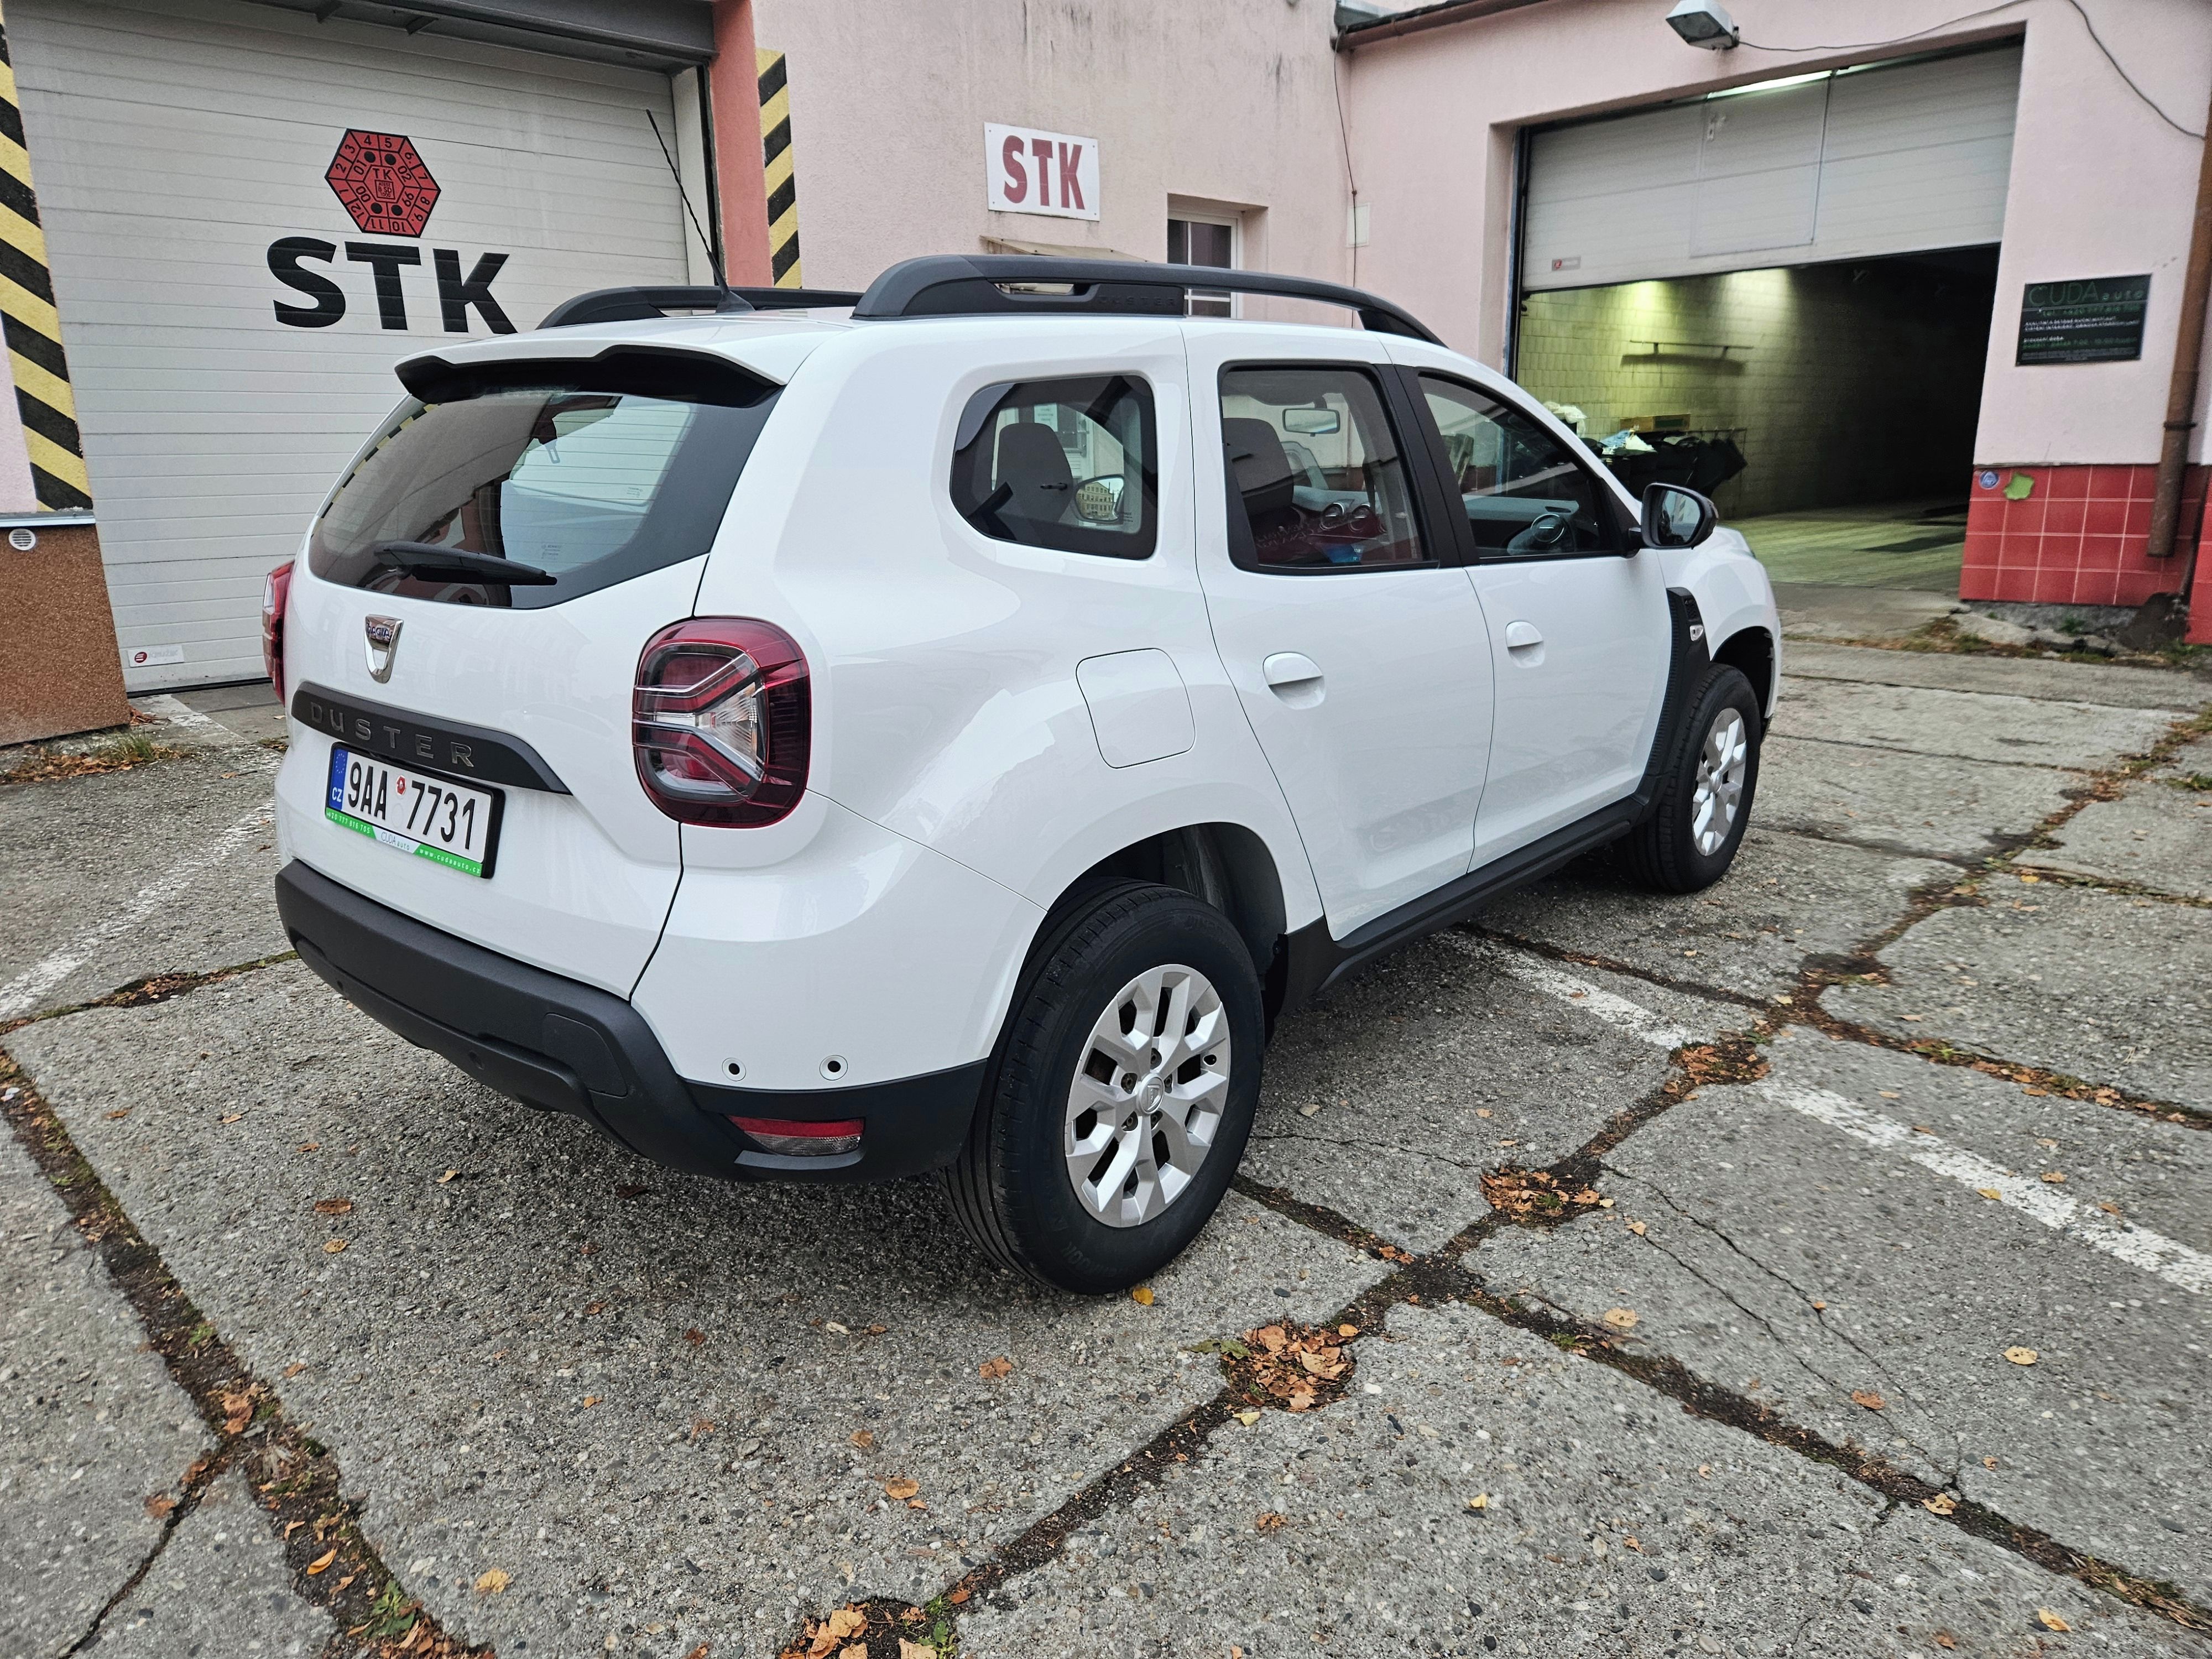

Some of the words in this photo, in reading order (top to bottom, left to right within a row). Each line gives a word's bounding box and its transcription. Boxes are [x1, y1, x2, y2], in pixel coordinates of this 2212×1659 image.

[364, 135, 372, 145] 4
[384, 138, 392, 148] 5
[345, 144, 355, 154] 3
[336, 164, 346, 173] 2
[1003, 135, 1086, 210] STK
[420, 196, 430, 205] 8
[351, 204, 364, 219] 12
[371, 219, 384, 230] 11
[392, 222, 406, 232] 10
[267, 236, 518, 335] STK
[2029, 281, 2099, 305] CUDA
[310, 701, 474, 768] DUSTER
[332, 786, 343, 802] CZ
[348, 761, 387, 820] 9AA
[406, 780, 476, 851] 7731
[381, 831, 396, 845] CUDA
[397, 840, 410, 851] auto
[419, 848, 481, 874] www.cudaauto.cz
